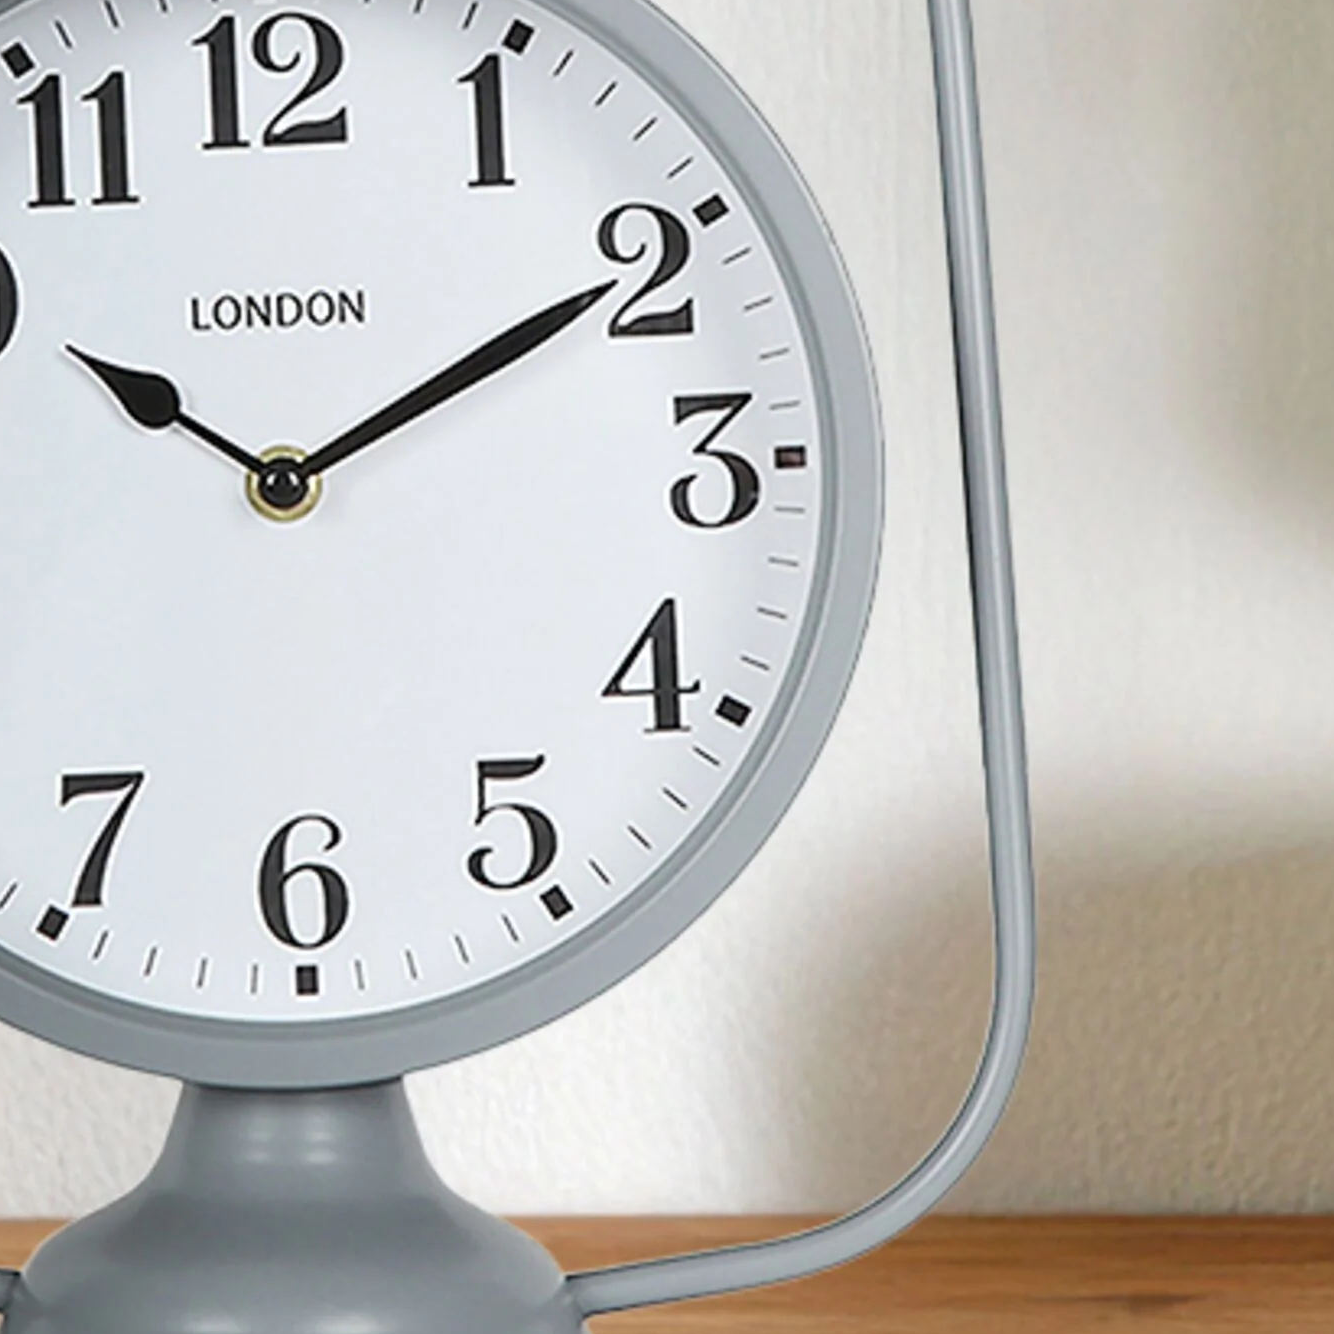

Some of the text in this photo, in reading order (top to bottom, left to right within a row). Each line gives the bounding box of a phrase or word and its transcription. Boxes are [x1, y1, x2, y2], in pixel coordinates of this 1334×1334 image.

[17, 71, 140, 209] 11
[192, 12, 348, 150] 12
[457, 54, 517, 188] 1
[191, 289, 365, 331] LONDON
[597, 203, 696, 338] 2
[670, 393, 761, 528] 3
[601, 597, 702, 734] 4
[59, 771, 146, 907] 7
[258, 815, 350, 950] 6
[466, 753, 558, 890] 5
